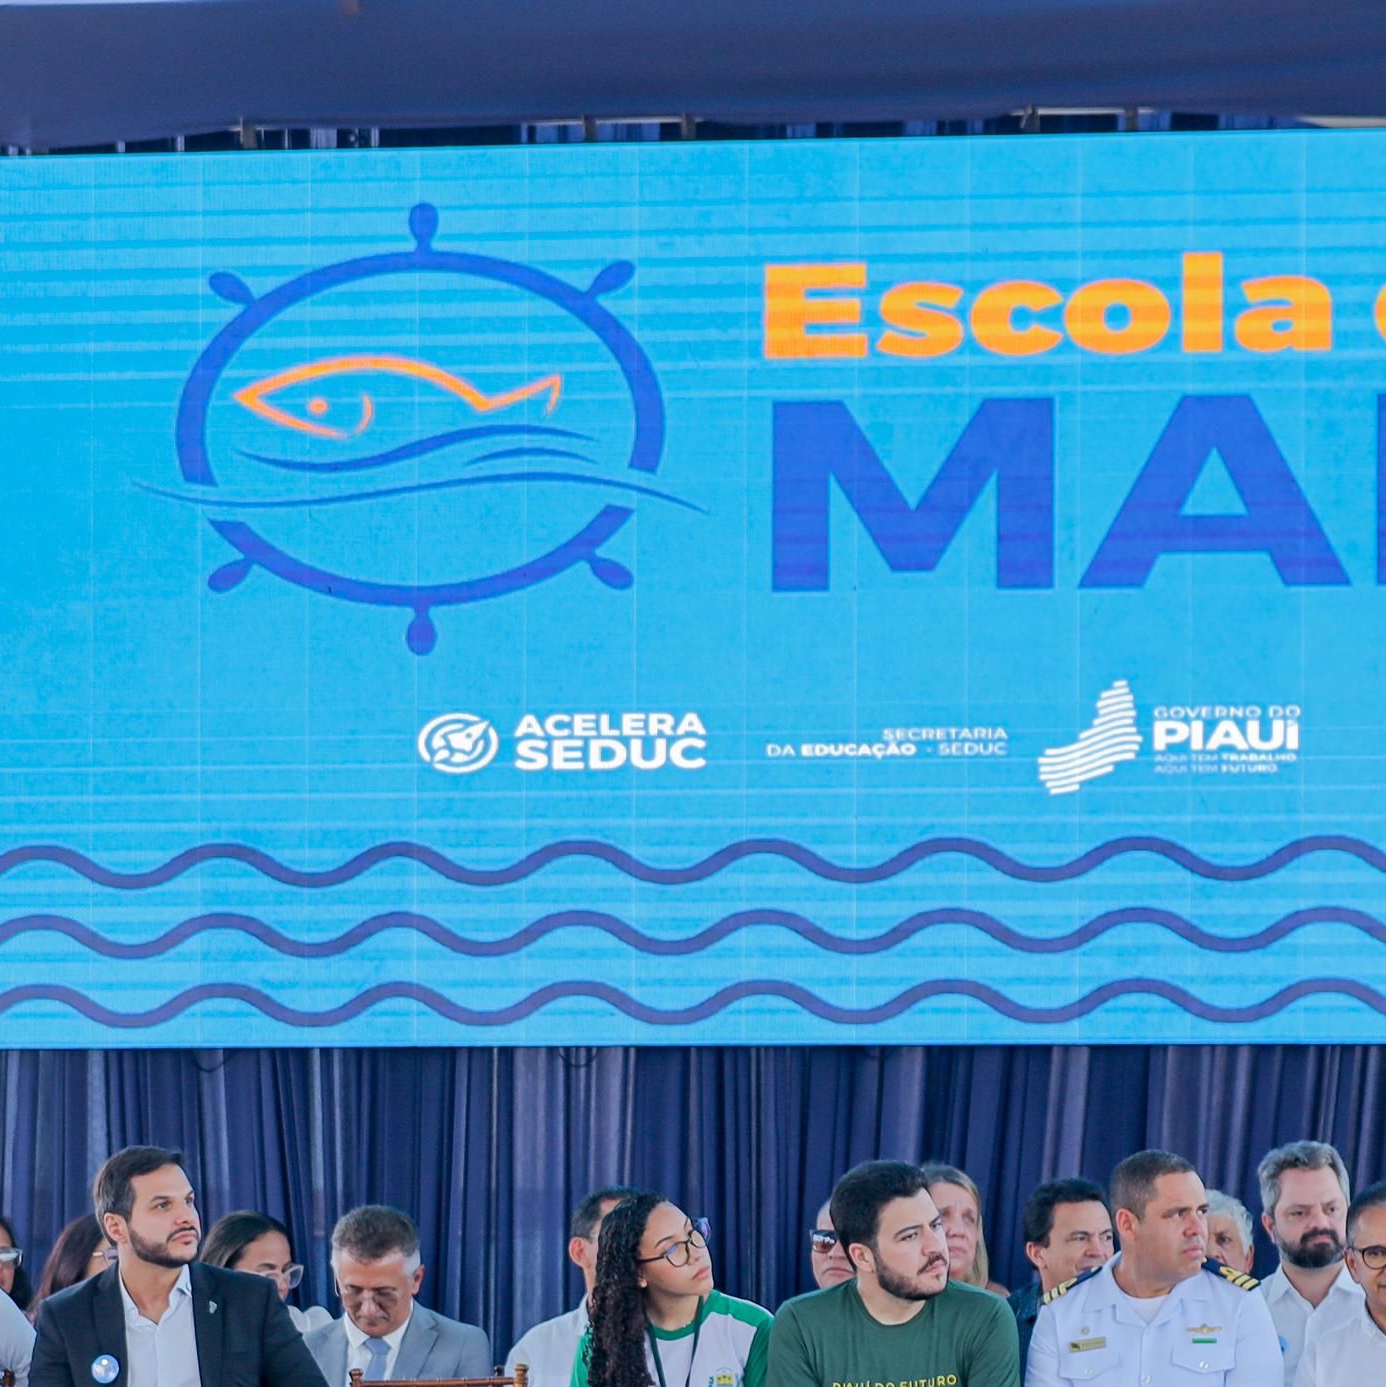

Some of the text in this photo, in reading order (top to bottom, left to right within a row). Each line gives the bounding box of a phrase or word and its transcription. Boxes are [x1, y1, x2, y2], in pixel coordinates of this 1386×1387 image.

[763, 250, 1334, 360] Escola
[1152, 704, 1302, 719] GOVERNO DO
[513, 713, 707, 737] ACELERA
[881, 726, 1009, 741] SECRETARIA
[1152, 719, 1300, 751] PIAUÍ
[513, 737, 707, 771] SEDUC
[765, 743, 796, 757] DA
[800, 740, 918, 760] EDUCAÇÃO
[937, 741, 1009, 757] SEDUC
[1220, 752, 1298, 763] TRABALHO
[1220, 763, 1279, 773] FUTURO
